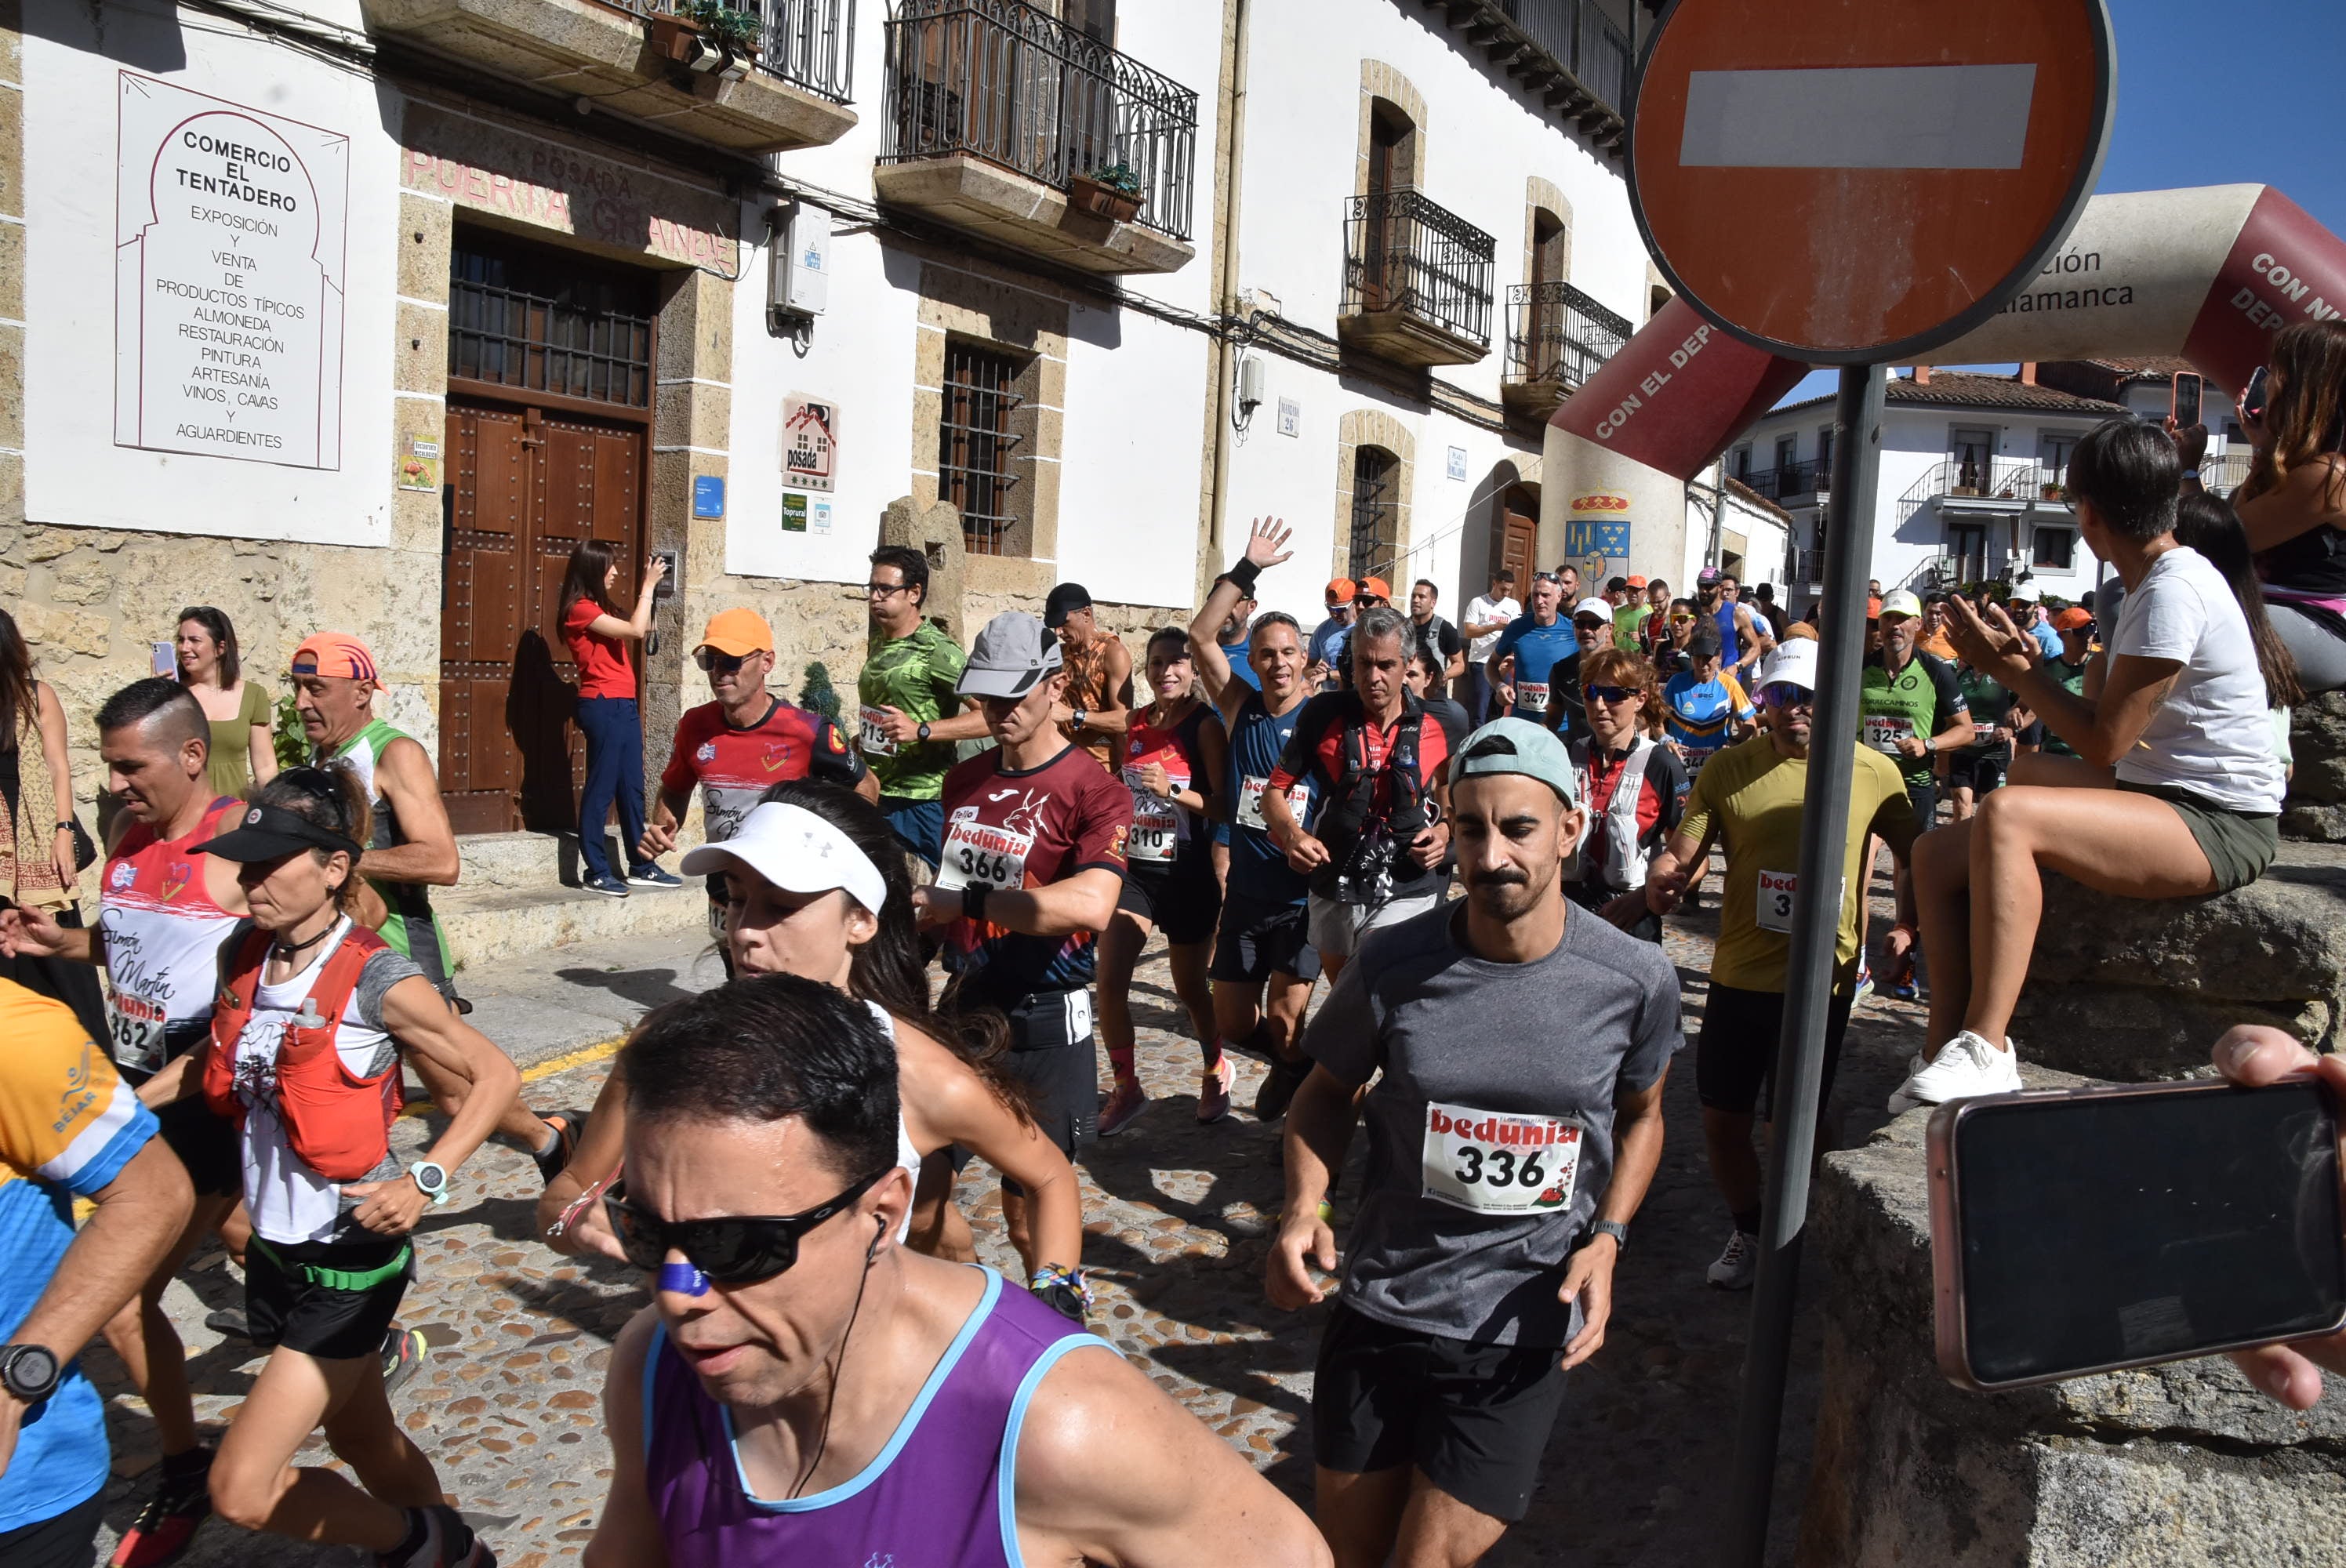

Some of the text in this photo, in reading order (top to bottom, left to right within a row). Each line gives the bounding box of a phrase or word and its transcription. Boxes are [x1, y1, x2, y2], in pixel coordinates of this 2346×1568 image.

[183, 131, 291, 172] COMERCIO
[227, 162, 249, 182] EL
[531, 151, 632, 198] POSADA
[176, 168, 296, 212] TENTADERO
[407, 148, 735, 268] PUERTA GRANDE
[191, 205, 278, 237] EXPOSICIÓN
[231, 234, 240, 247] Y
[212, 249, 257, 271] VENTA
[2041, 246, 2101, 275] ión
[224, 272, 244, 288] DE
[2251, 252, 2346, 321] CON N
[156, 278, 305, 319] PRODUCTOS TÍPICOS
[2230, 287, 2285, 330] DEP
[193, 307, 271, 332] ALMONEDA
[179, 323, 285, 354] RESTAURACIÓN
[202, 347, 262, 369] PINTURA
[191, 365, 271, 390] ARTESANÍA
[1596, 323, 1719, 439] CON EL DEP
[183, 383, 278, 410] VINOS, CAVAS
[226, 410, 235, 423] Y
[1285, 417, 1294, 432] 26
[176, 423, 282, 448] AGUARDIENTES
[787, 447, 817, 471] posada
[783, 506, 806, 517] Toprural
[1518, 682, 1549, 692] beduni
[1524, 693, 1546, 704] 347
[1861, 698, 1919, 708] CORRECAMINOS
[861, 721, 885, 743] 313
[1865, 717, 1912, 730] bedunia
[1872, 729, 1902, 743] 325
[1680, 748, 1713, 757] edunia
[706, 789, 745, 822] Simón
[1131, 814, 1176, 828] edunia
[950, 825, 1028, 858] bedunia
[1131, 827, 1163, 848] 310
[959, 848, 1007, 883] 366
[1760, 873, 1796, 891] bed
[1774, 894, 1791, 916] 3
[100, 908, 142, 955] Simón
[111, 1012, 149, 1051] 362
[1430, 1109, 1579, 1145] bedunia
[1454, 1145, 1545, 1188] 336
